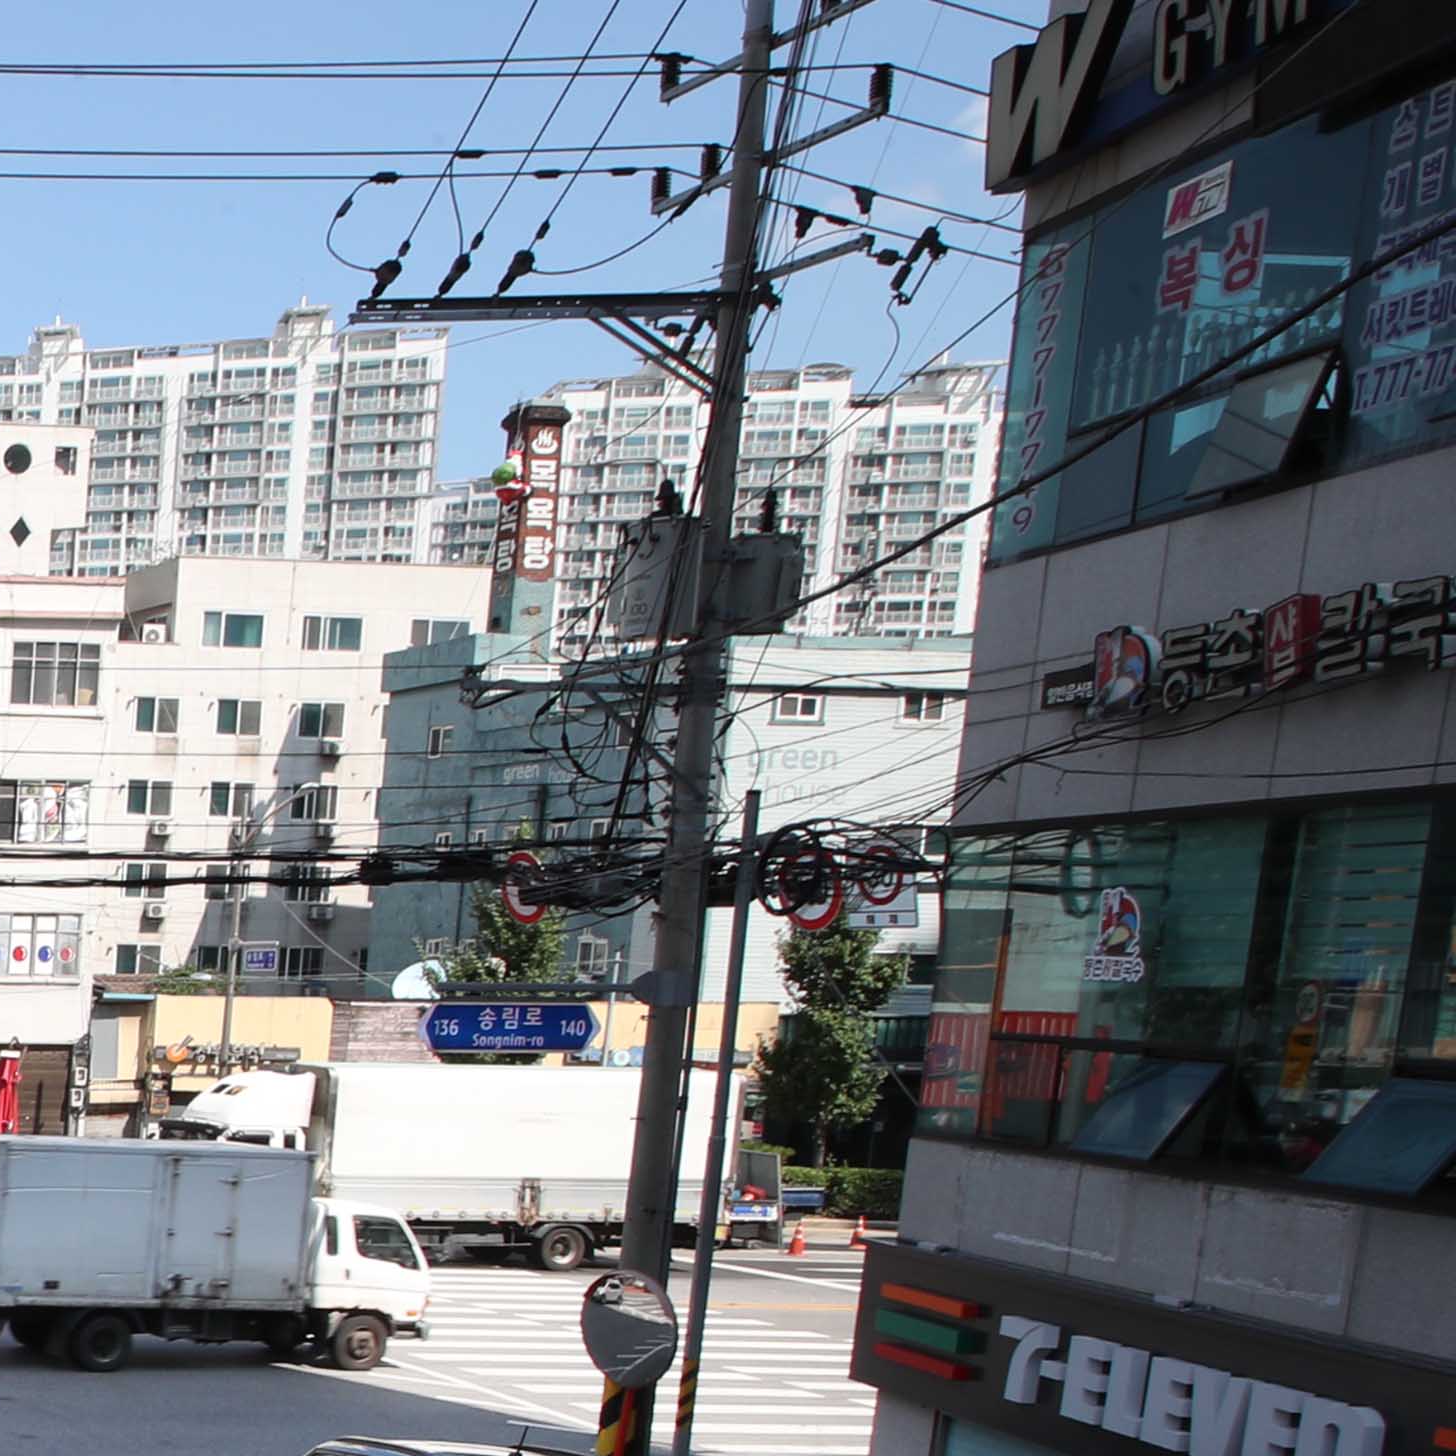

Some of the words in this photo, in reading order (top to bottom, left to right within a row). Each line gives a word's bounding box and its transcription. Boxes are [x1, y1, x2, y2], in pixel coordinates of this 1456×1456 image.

[985, 0, 1114, 190] W
[1158, 214, 1268, 314] 복싱
[1360, 279, 1456, 348] 서킷트레
[1351, 341, 1456, 416] T.777-77
[496, 500, 519, 574] 욕탕
[522, 459, 558, 571] 목욕탕
[748, 749, 838, 776] green
[433, 1019, 460, 1036] 136
[471, 1032, 545, 1050] Songnim-ro
[477, 1007, 544, 1030] 송림로
[560, 1019, 587, 1037] 140
